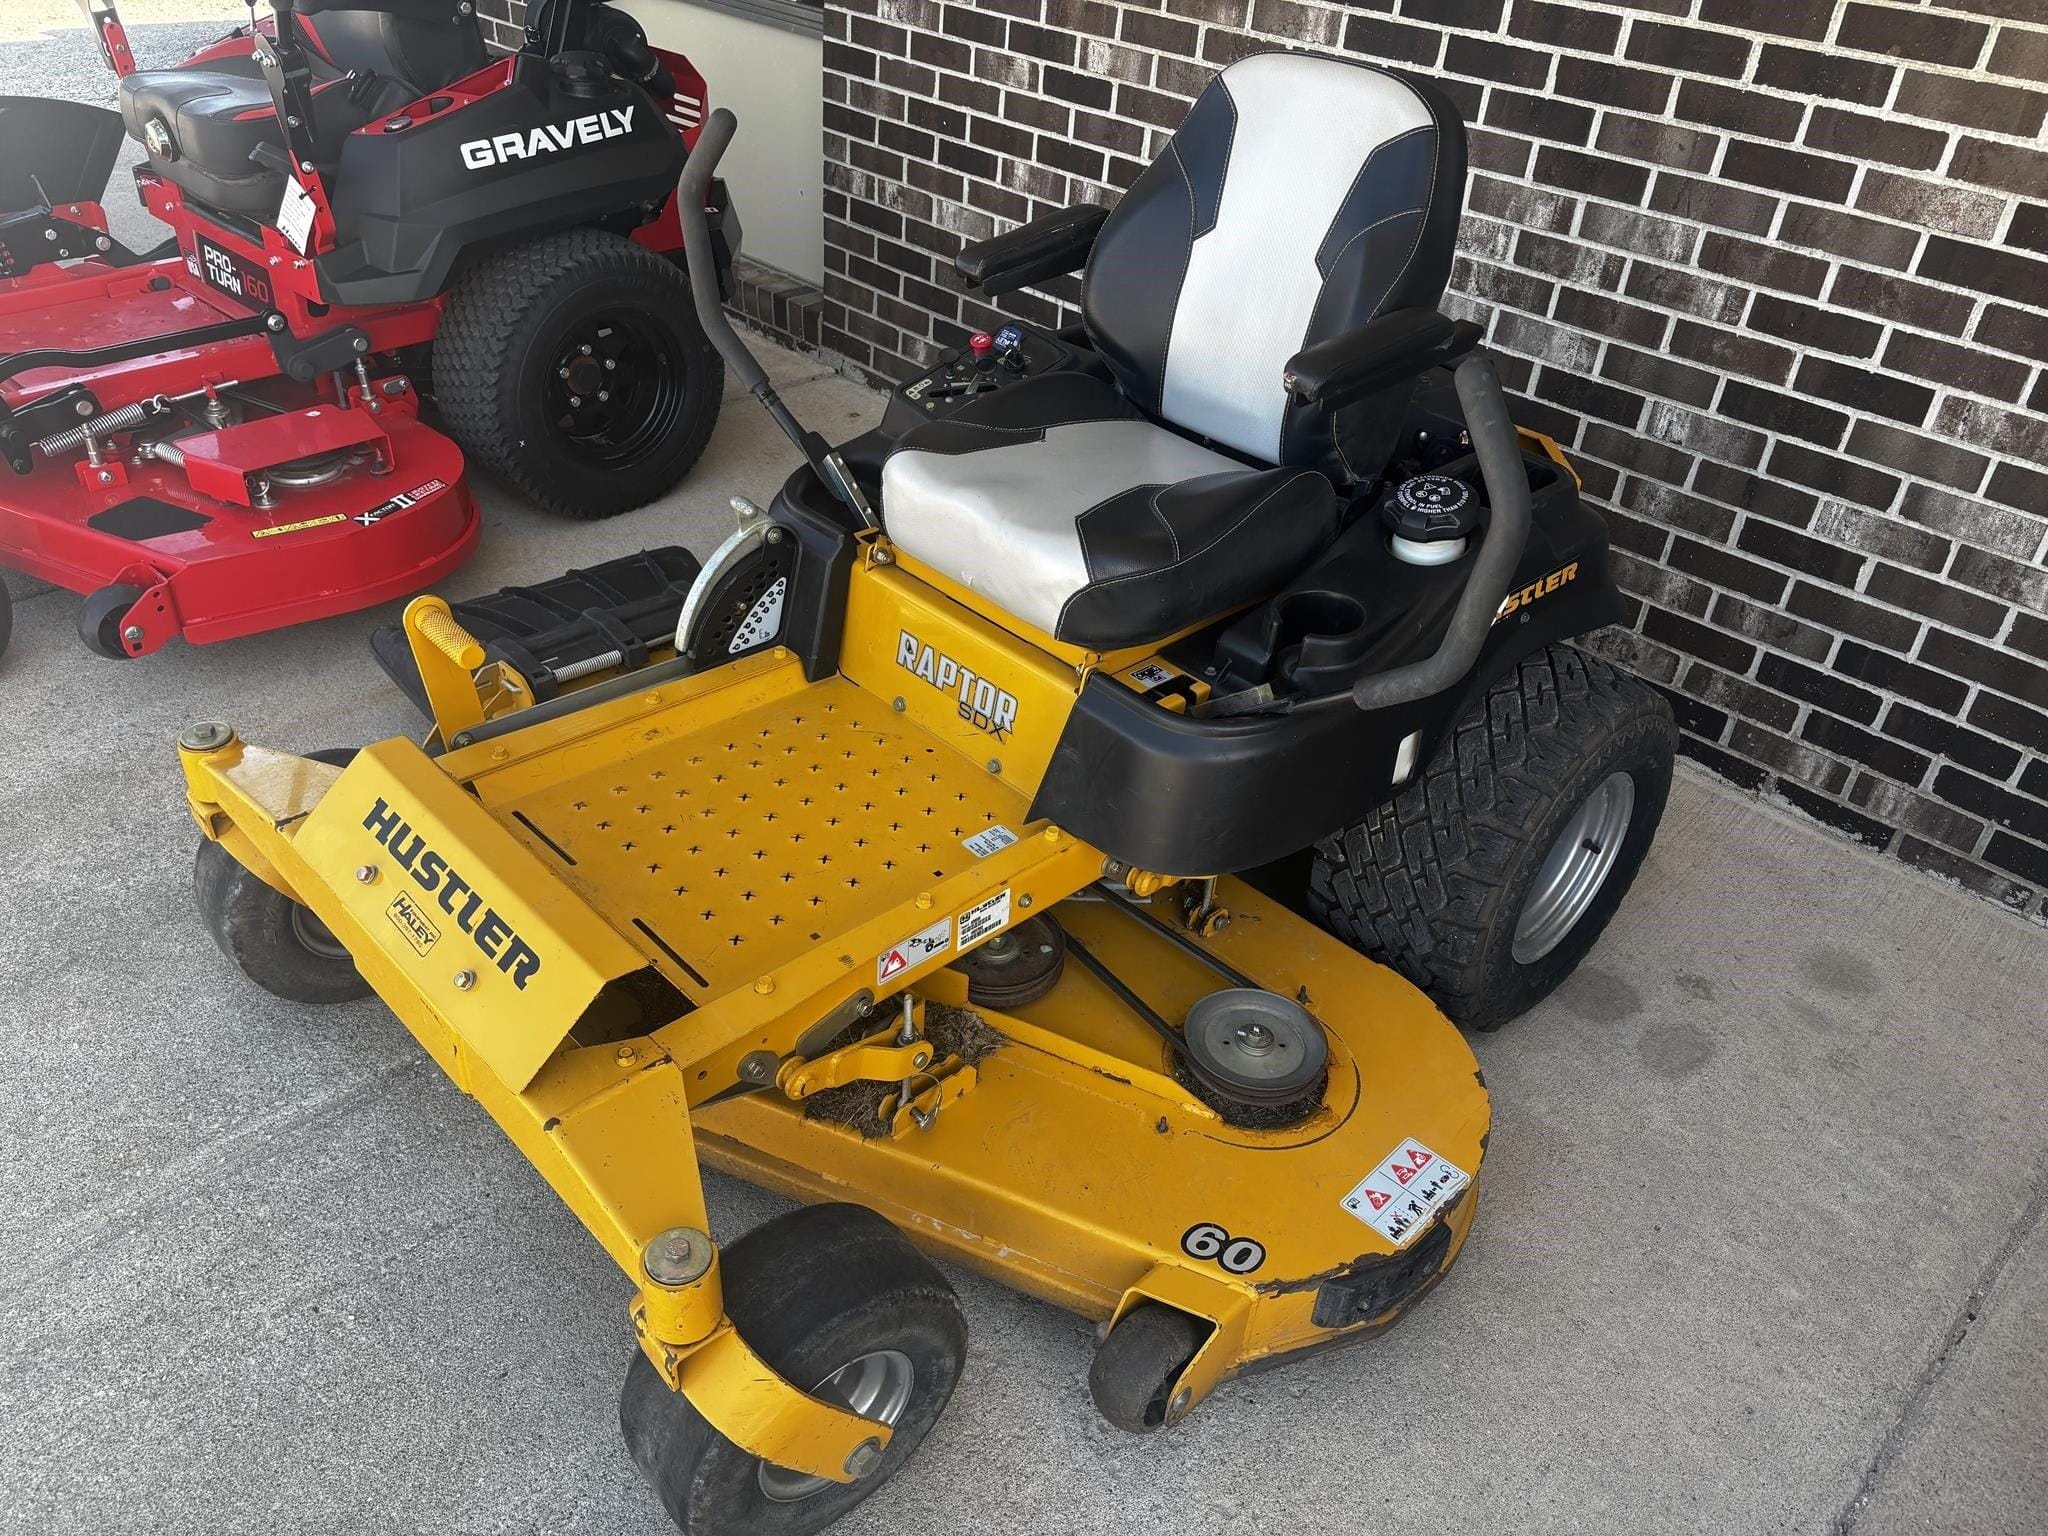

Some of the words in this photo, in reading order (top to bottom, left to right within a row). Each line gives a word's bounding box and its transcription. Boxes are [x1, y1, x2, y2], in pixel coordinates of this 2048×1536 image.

[460, 105, 635, 170] GRAVELY
[203, 244, 237, 273] PRO-
[206, 262, 242, 296] TURN
[241, 271, 269, 304] 160
[1442, 504, 1459, 513] THAN
[1498, 562, 1579, 618] STLER
[896, 628, 1019, 735] RAPTOR
[958, 701, 1006, 746] SDX
[362, 796, 541, 991] HUSTLER
[392, 896, 435, 945] HALEY
[1181, 1222, 1267, 1276] 60
